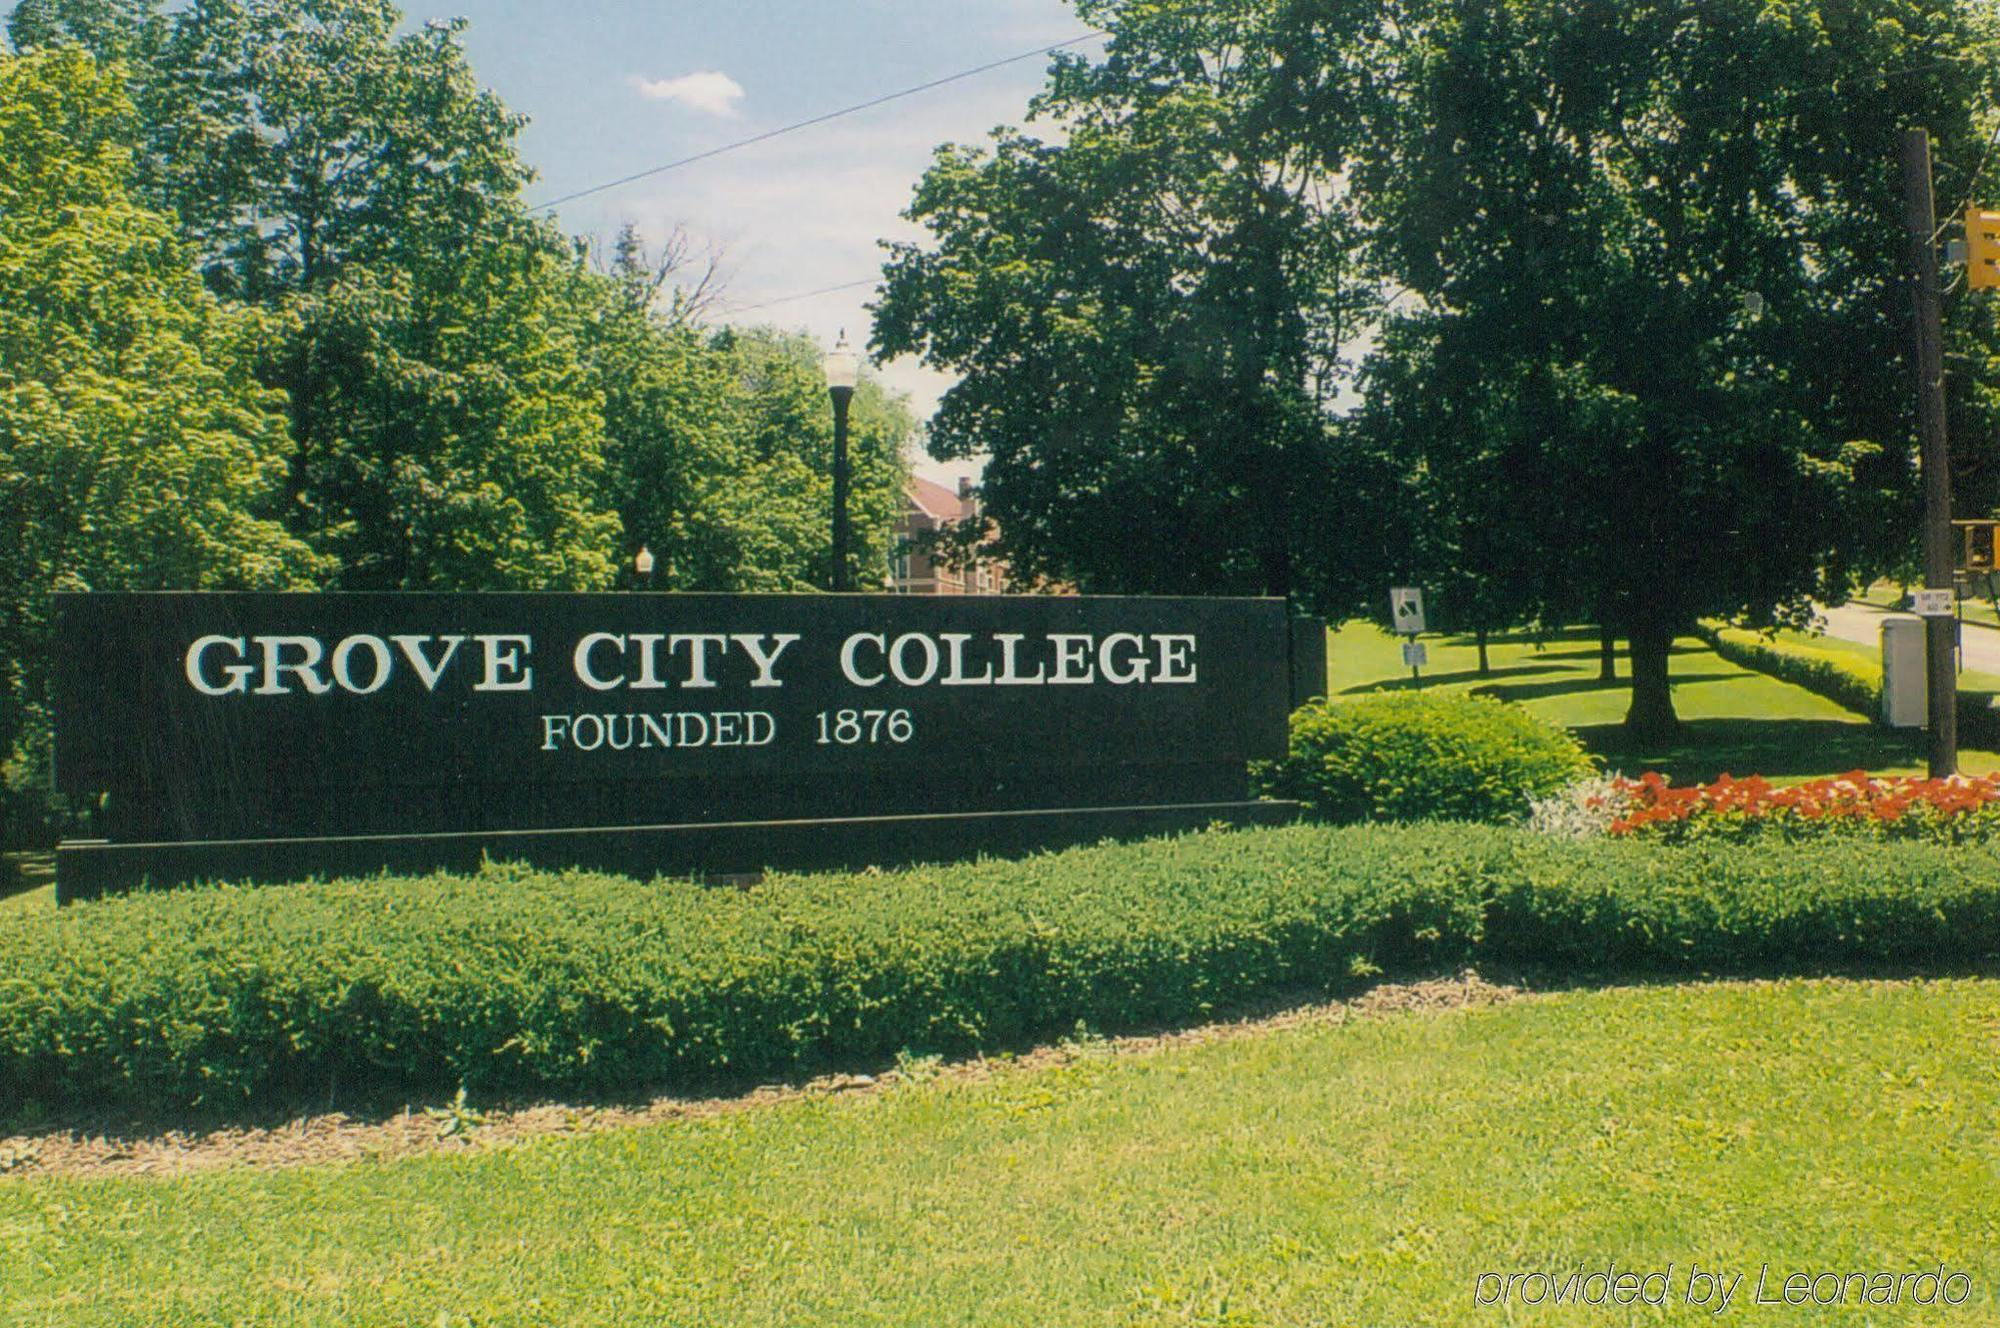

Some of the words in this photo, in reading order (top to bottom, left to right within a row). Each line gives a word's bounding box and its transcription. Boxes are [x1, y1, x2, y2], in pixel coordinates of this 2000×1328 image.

[186, 634, 531, 695] GROVE
[574, 632, 800, 690] CITY
[841, 633, 1196, 686] COLLEGE
[542, 712, 775, 750] FOUNDED
[817, 709, 913, 744] 1876
